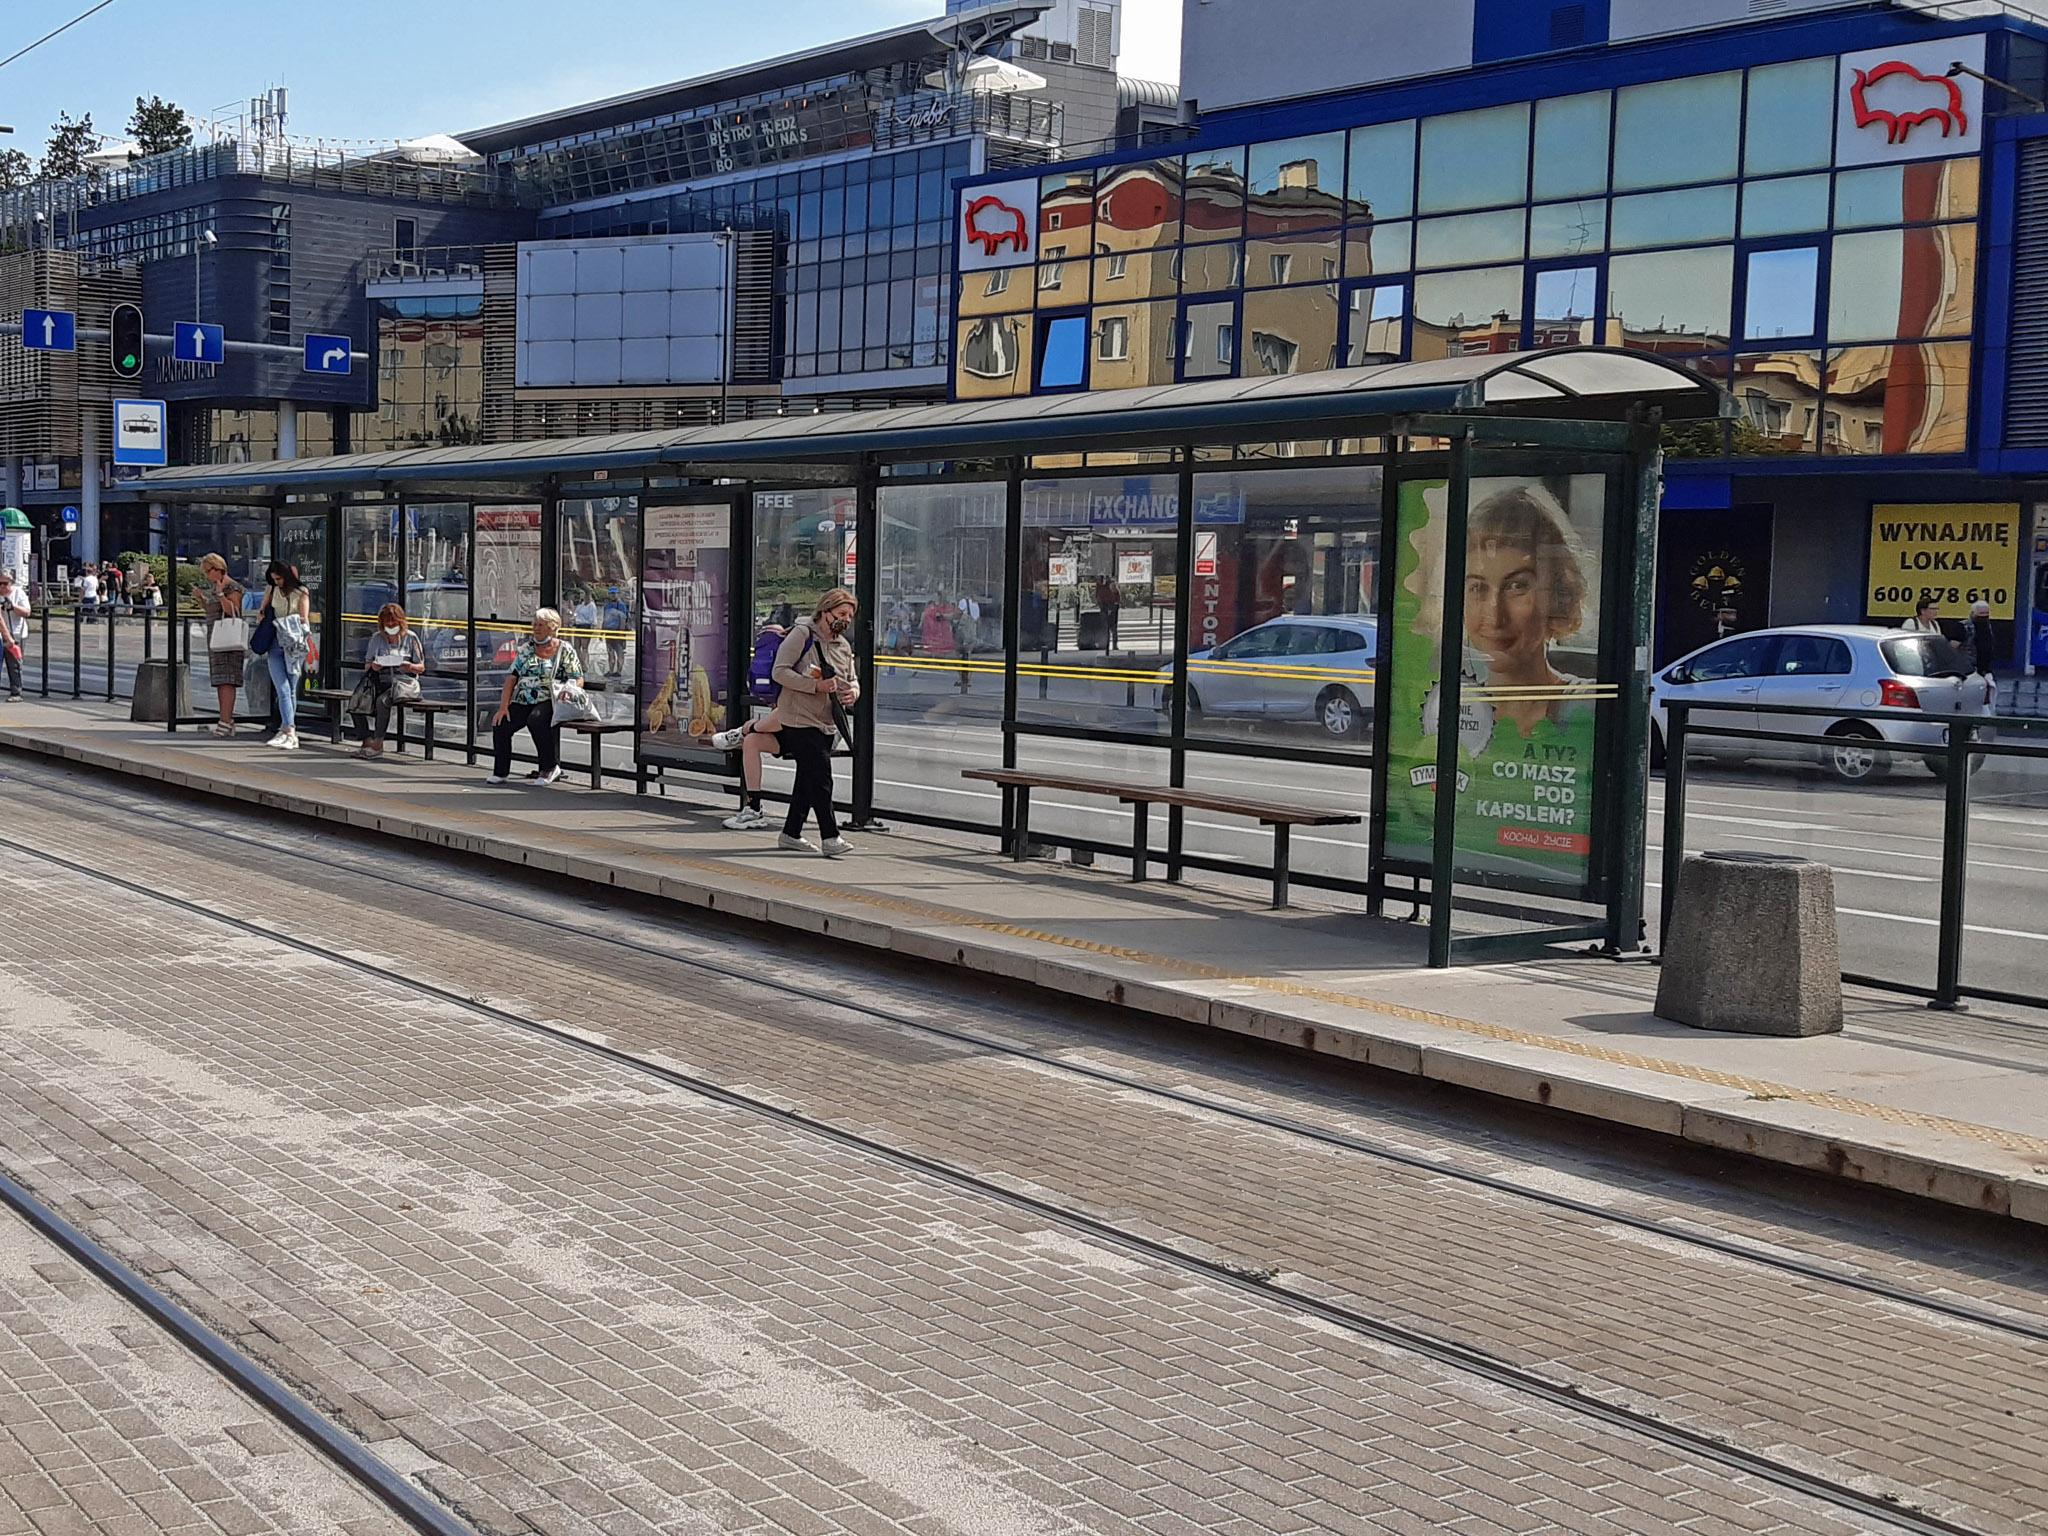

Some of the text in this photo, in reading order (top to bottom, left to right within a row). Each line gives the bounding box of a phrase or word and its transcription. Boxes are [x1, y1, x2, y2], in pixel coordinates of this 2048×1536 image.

[893, 97, 958, 128] niebo
[710, 126, 751, 146] BISTRO
[716, 158, 733, 173] BO
[757, 494, 794, 508] FFEE
[1094, 494, 1178, 524] EXCHANG
[1879, 522, 2009, 547] WYNAJMĘ
[1900, 551, 1984, 571] LOKAL
[1874, 587, 2007, 604] 600 878 610
[1202, 573, 1220, 646] NTOR
[1523, 742, 1577, 761] A TY?
[1412, 767, 1465, 788] TYMK
[1492, 760, 1577, 785] CO MASZ
[1533, 785, 1575, 805] POD
[1476, 799, 1576, 826] KAPSLEM?
[1502, 830, 1573, 849] KOCHAJ ŻYCIE
